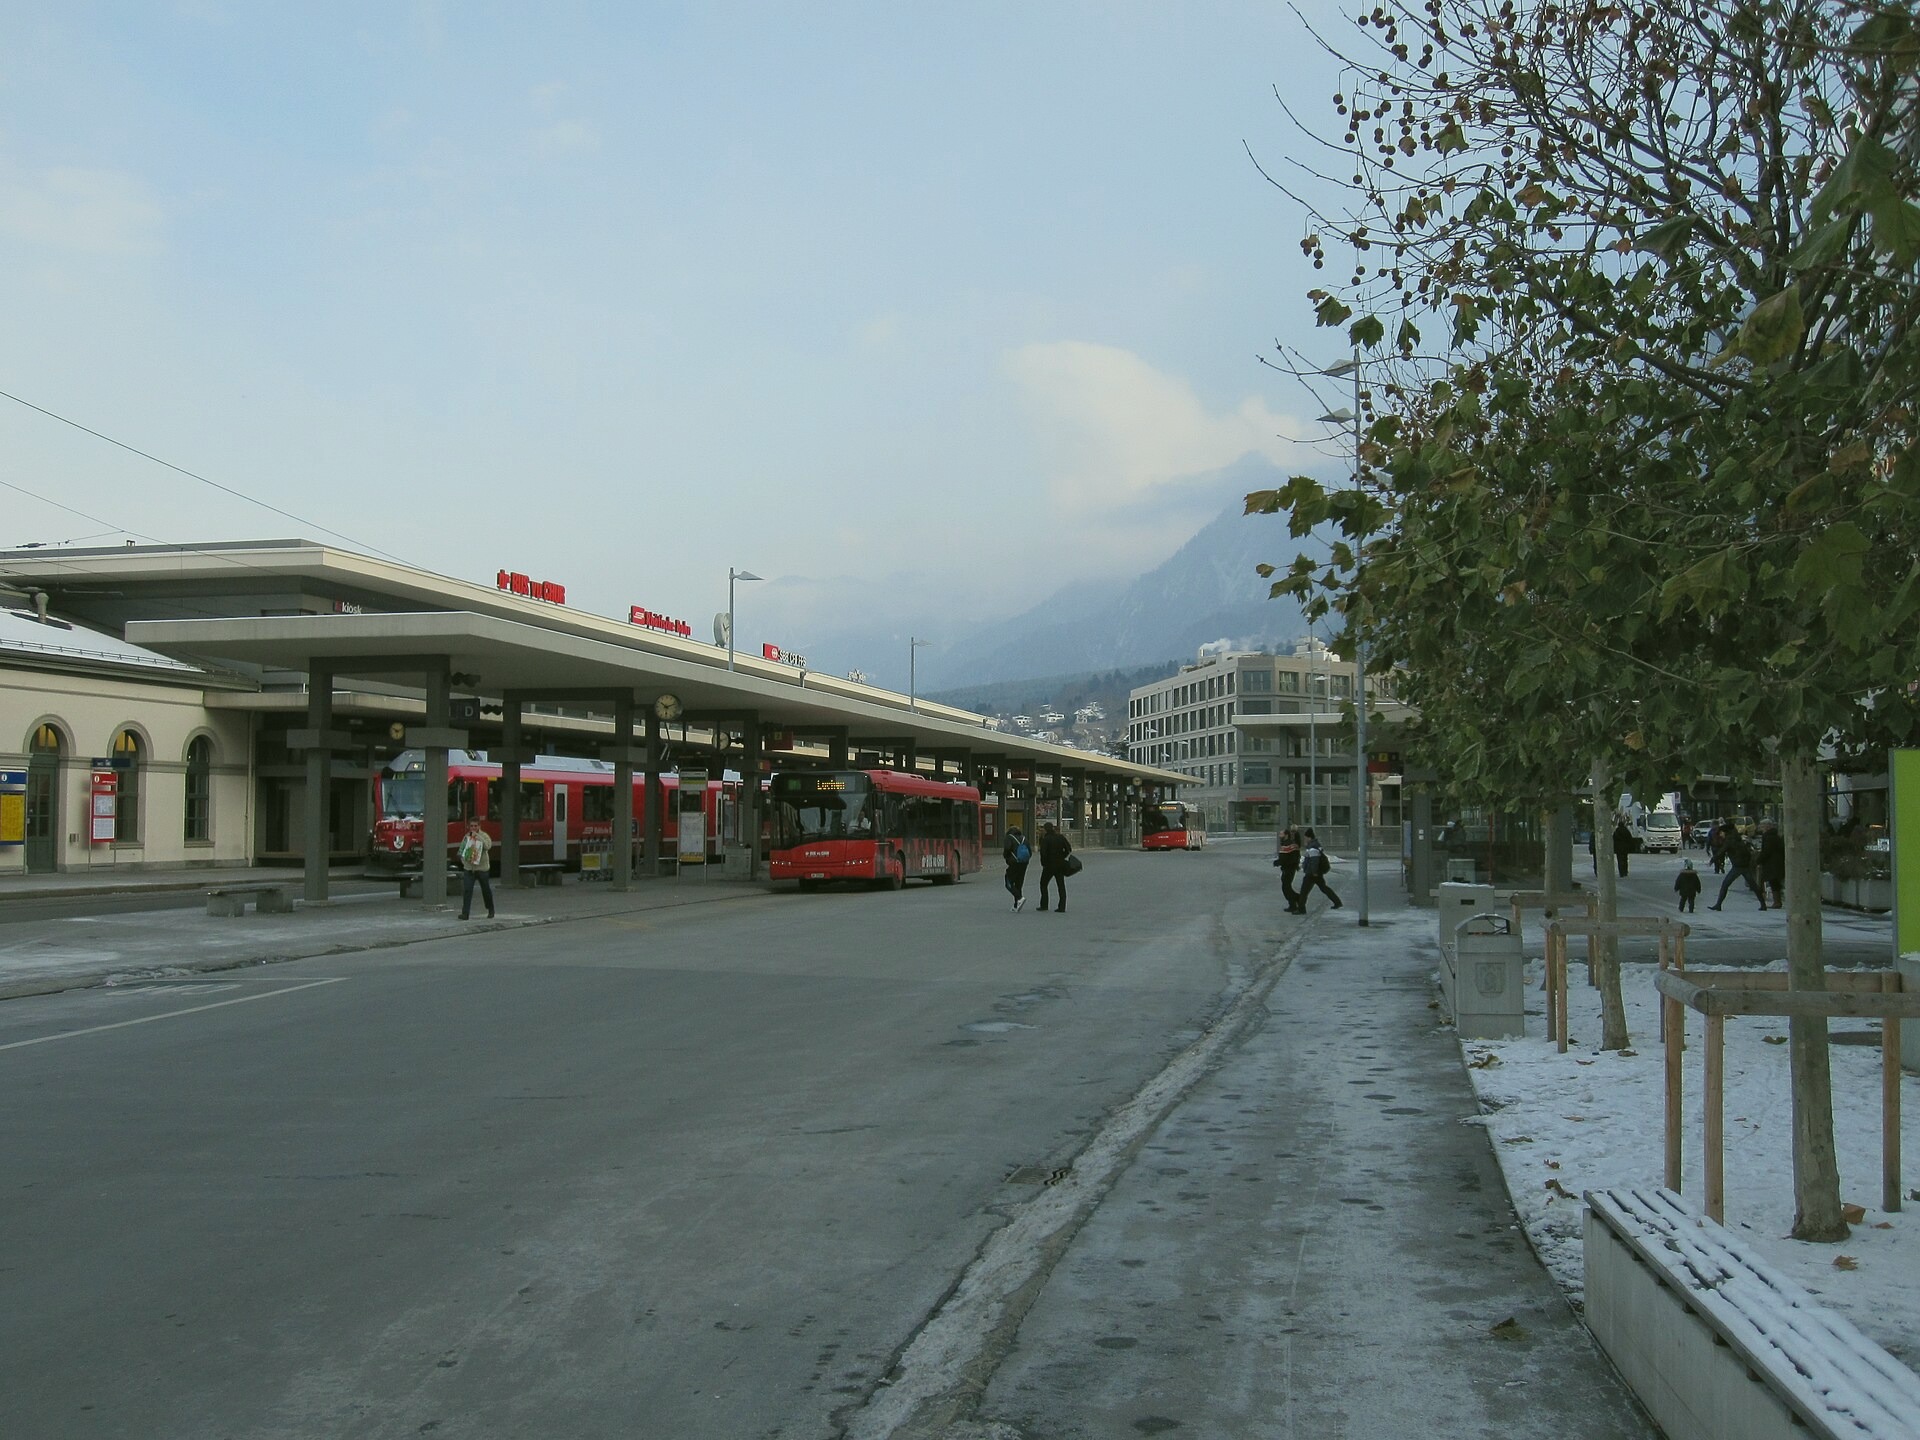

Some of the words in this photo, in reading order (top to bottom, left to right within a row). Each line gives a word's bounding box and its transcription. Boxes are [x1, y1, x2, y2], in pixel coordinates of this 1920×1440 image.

[510, 572, 529, 596] BUS
[542, 581, 566, 605] CHUR
[341, 601, 362, 614] kiosk
[465, 706, 473, 717] D
